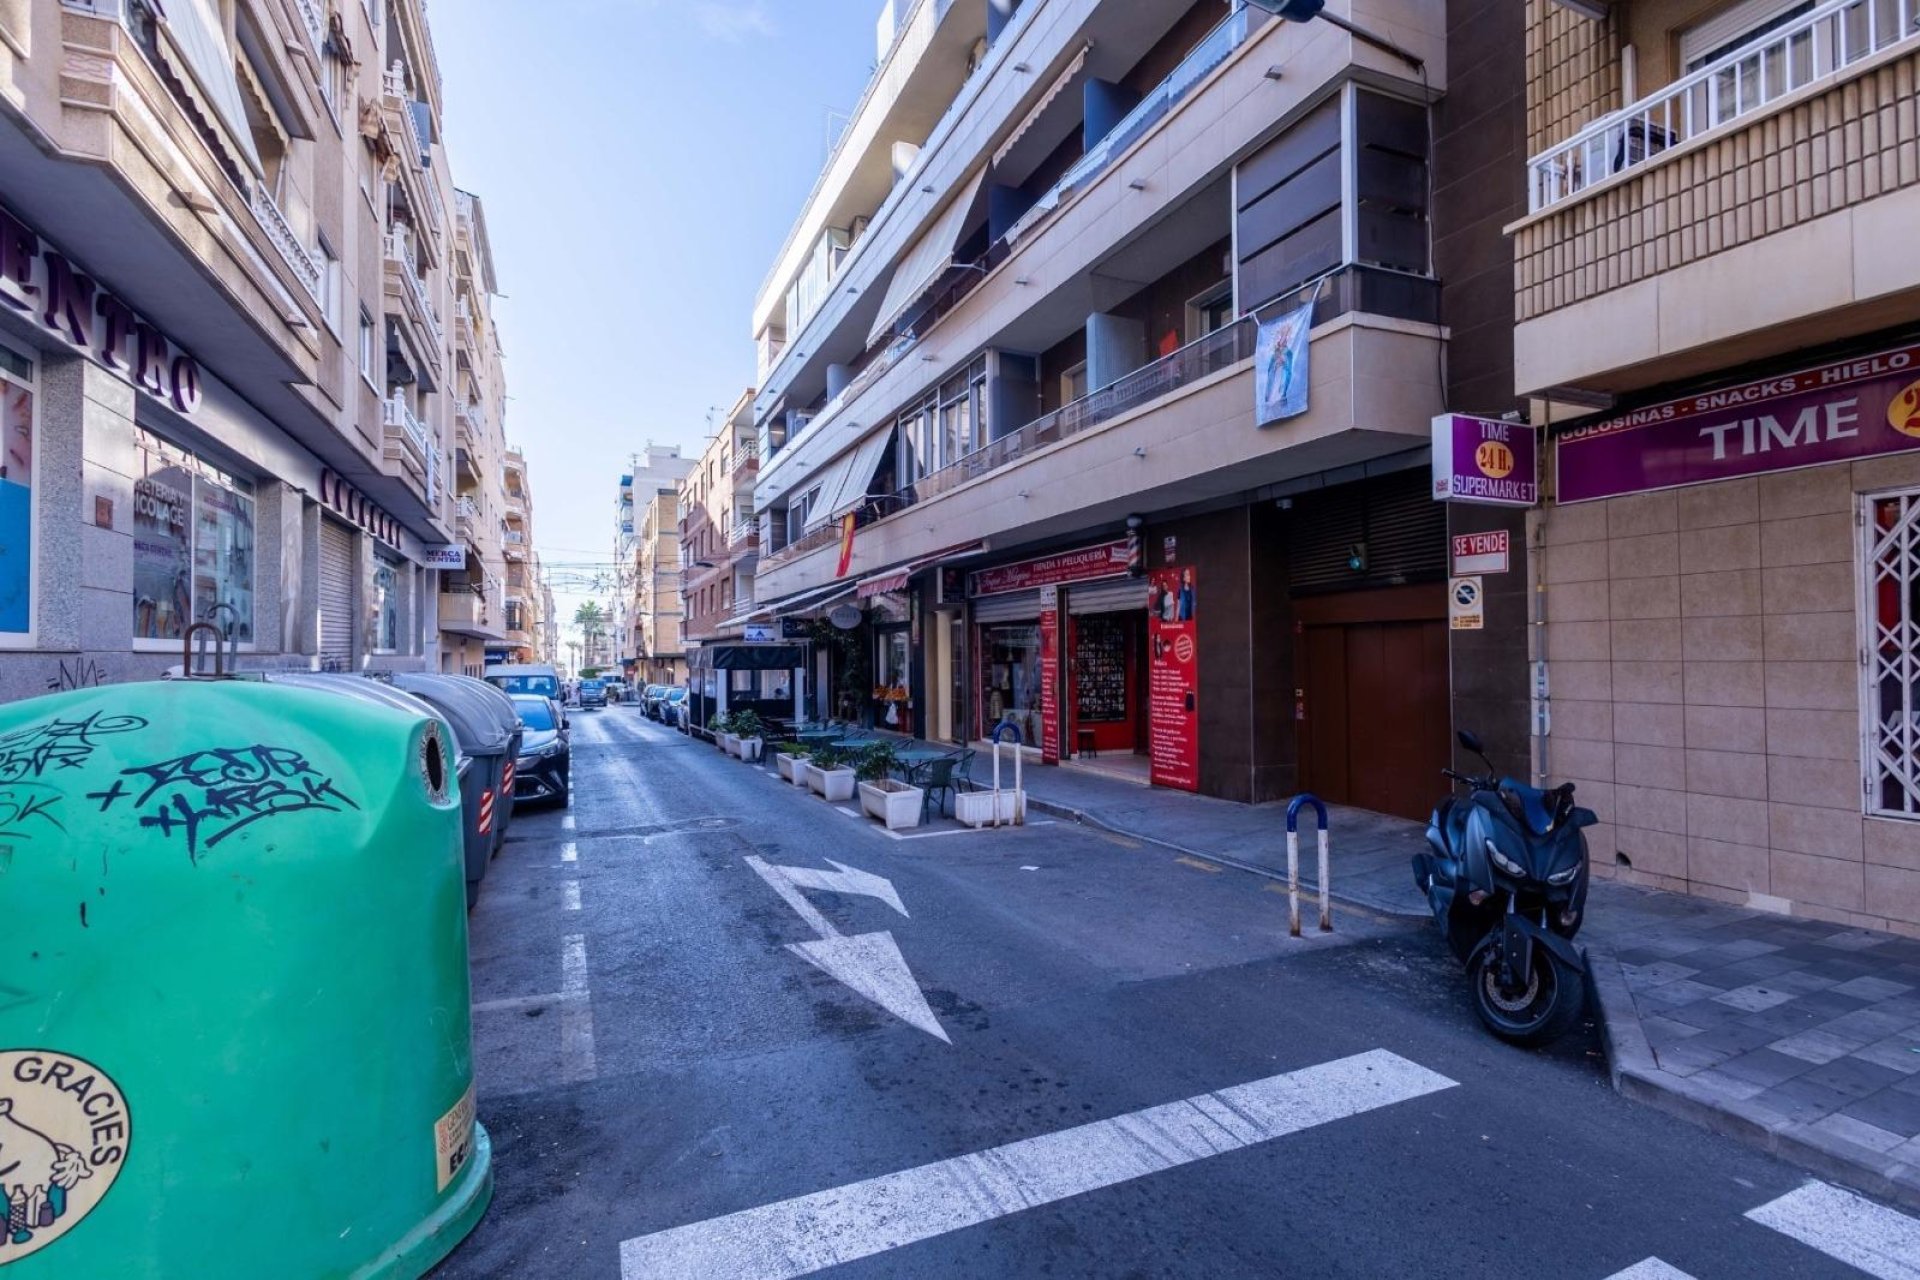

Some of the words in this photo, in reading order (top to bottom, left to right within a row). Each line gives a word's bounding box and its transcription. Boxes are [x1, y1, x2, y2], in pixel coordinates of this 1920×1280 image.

[1560, 406, 1675, 440] GOLOSINAS
[1696, 379, 1795, 411] SNACKS
[1820, 353, 1910, 384] HIELO
[1479, 421, 1509, 441] TIME
[1699, 397, 1859, 461] TIME
[1480, 447, 1494, 468] 24
[1453, 475, 1534, 500] SUPERMARKET
[1455, 538, 1467, 555] SE
[1470, 533, 1506, 553] VENDE
[1033, 560, 1055, 572] TIENDA
[13, 1056, 123, 1166] GRACIES
